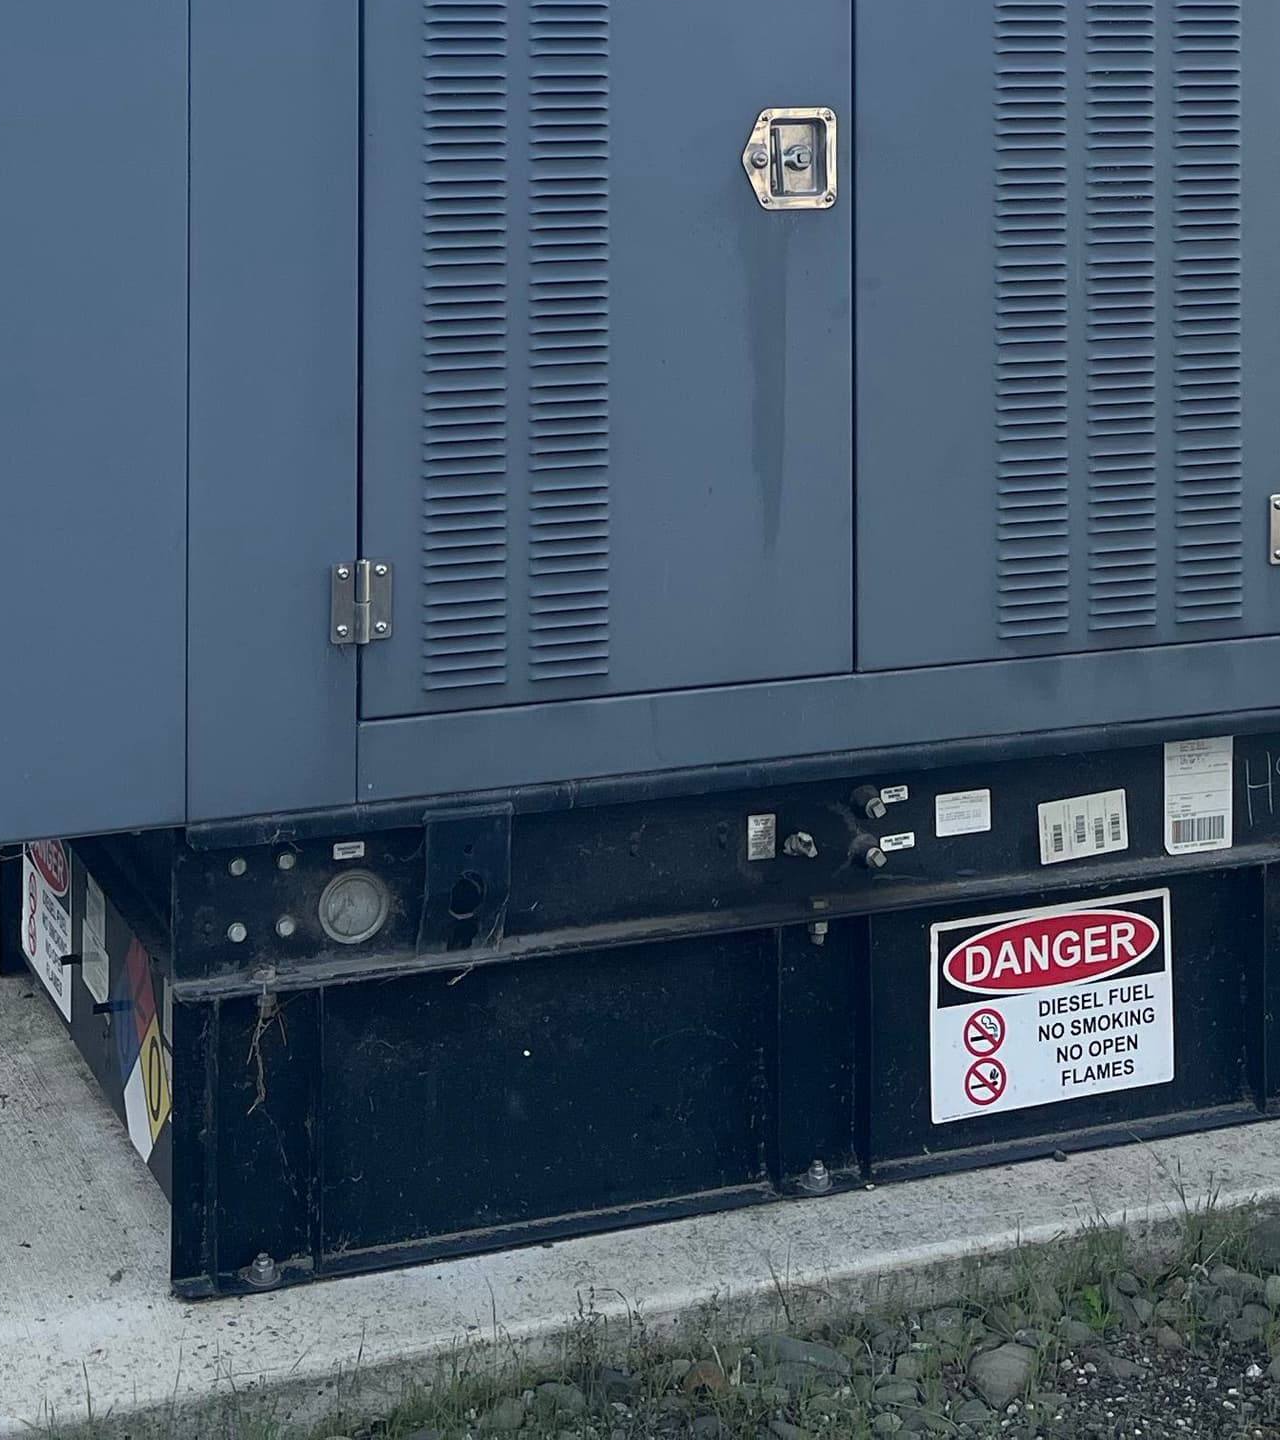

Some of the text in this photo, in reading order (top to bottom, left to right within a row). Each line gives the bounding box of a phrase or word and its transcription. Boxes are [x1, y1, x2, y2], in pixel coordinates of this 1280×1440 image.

[966, 921, 1138, 984] DANGER
[1038, 983, 1154, 1018] DIESEL FUEL
[1038, 1007, 1155, 1042] NO SMOKING
[1056, 1034, 1138, 1064] NO OPEN
[149, 1035, 161, 1122] 0
[1061, 1059, 1135, 1086] FLAMES
